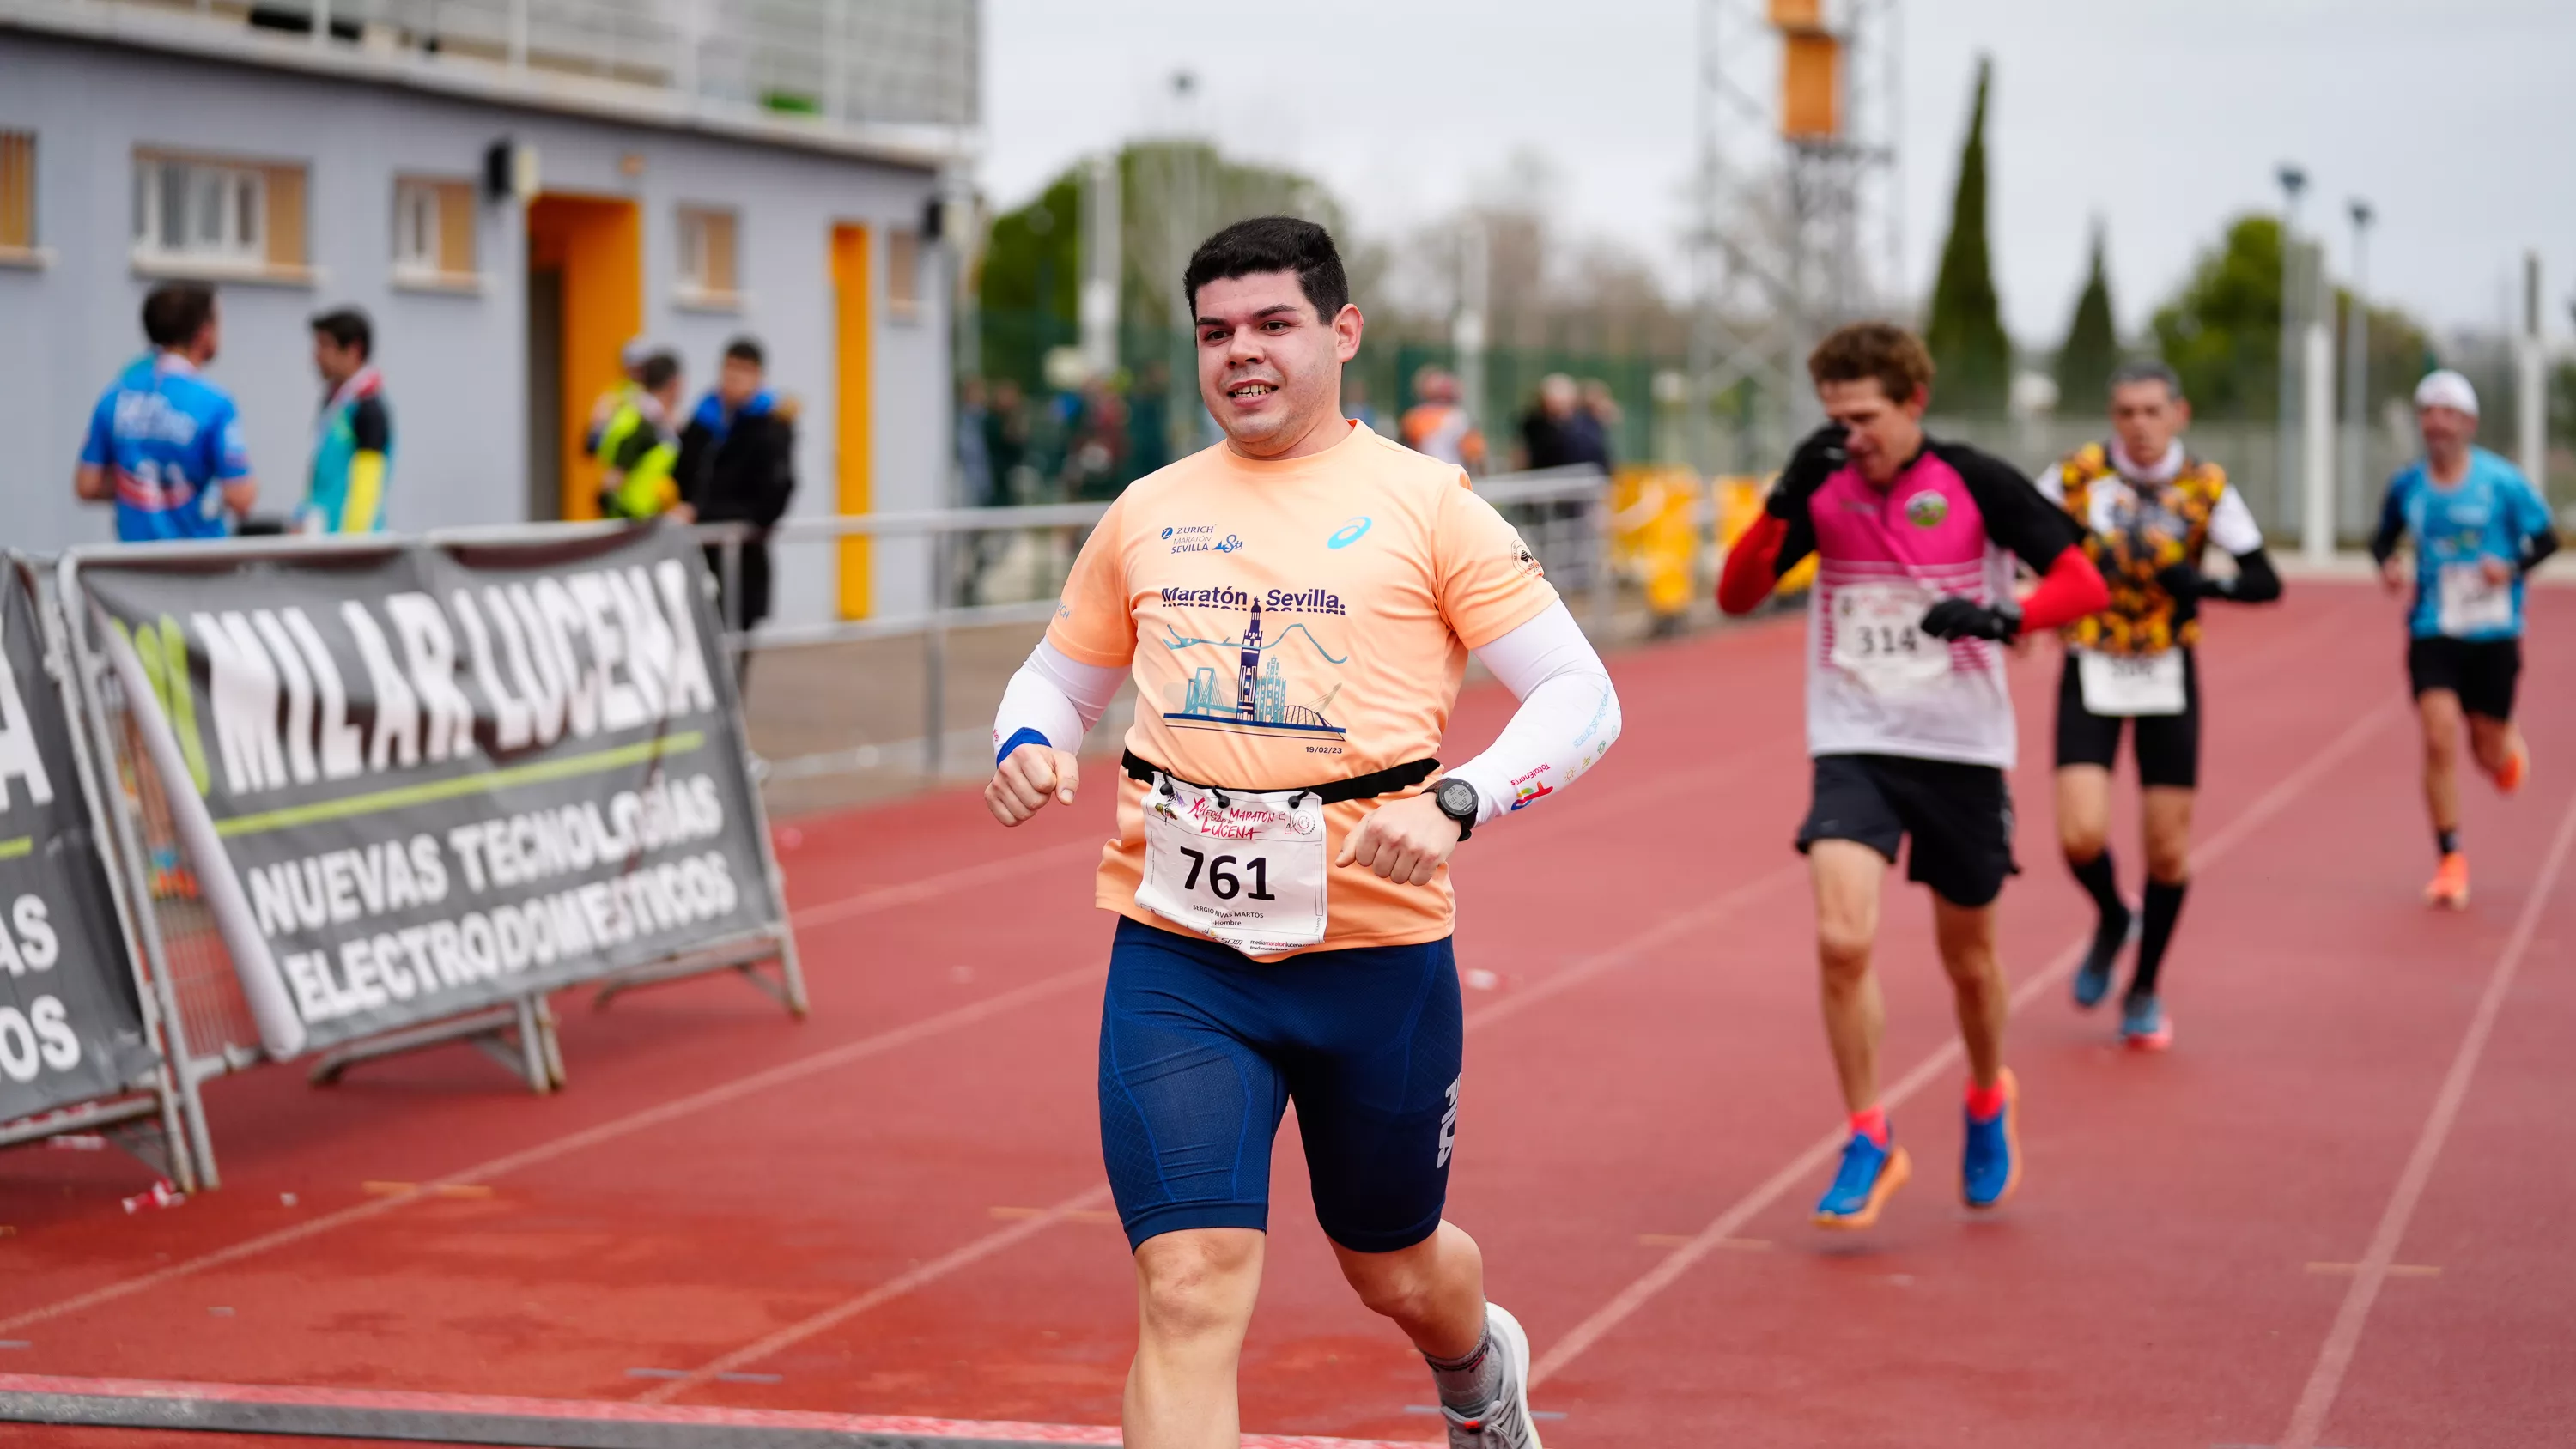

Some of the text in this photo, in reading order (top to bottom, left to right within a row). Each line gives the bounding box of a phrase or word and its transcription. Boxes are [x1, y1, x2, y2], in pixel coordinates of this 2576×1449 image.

[1176, 525, 1214, 534] ZURICH
[1171, 543, 1209, 554] SEVILLA
[1173, 535, 1212, 545] MARATÓN
[1161, 585, 1346, 610] Maratón Sevilla.
[1858, 625, 1918, 654] 314
[191, 558, 715, 795] MILAR LUCENA
[1305, 746, 1343, 755] 19/02/23
[1230, 807, 1275, 823] MARATÓN
[1201, 816, 1264, 840] LUCENA
[1180, 846, 1276, 900] 761
[249, 834, 448, 937] NUEVAS
[1193, 904, 1215, 914] SERGIO
[1214, 910, 1233, 919] RIVAS
